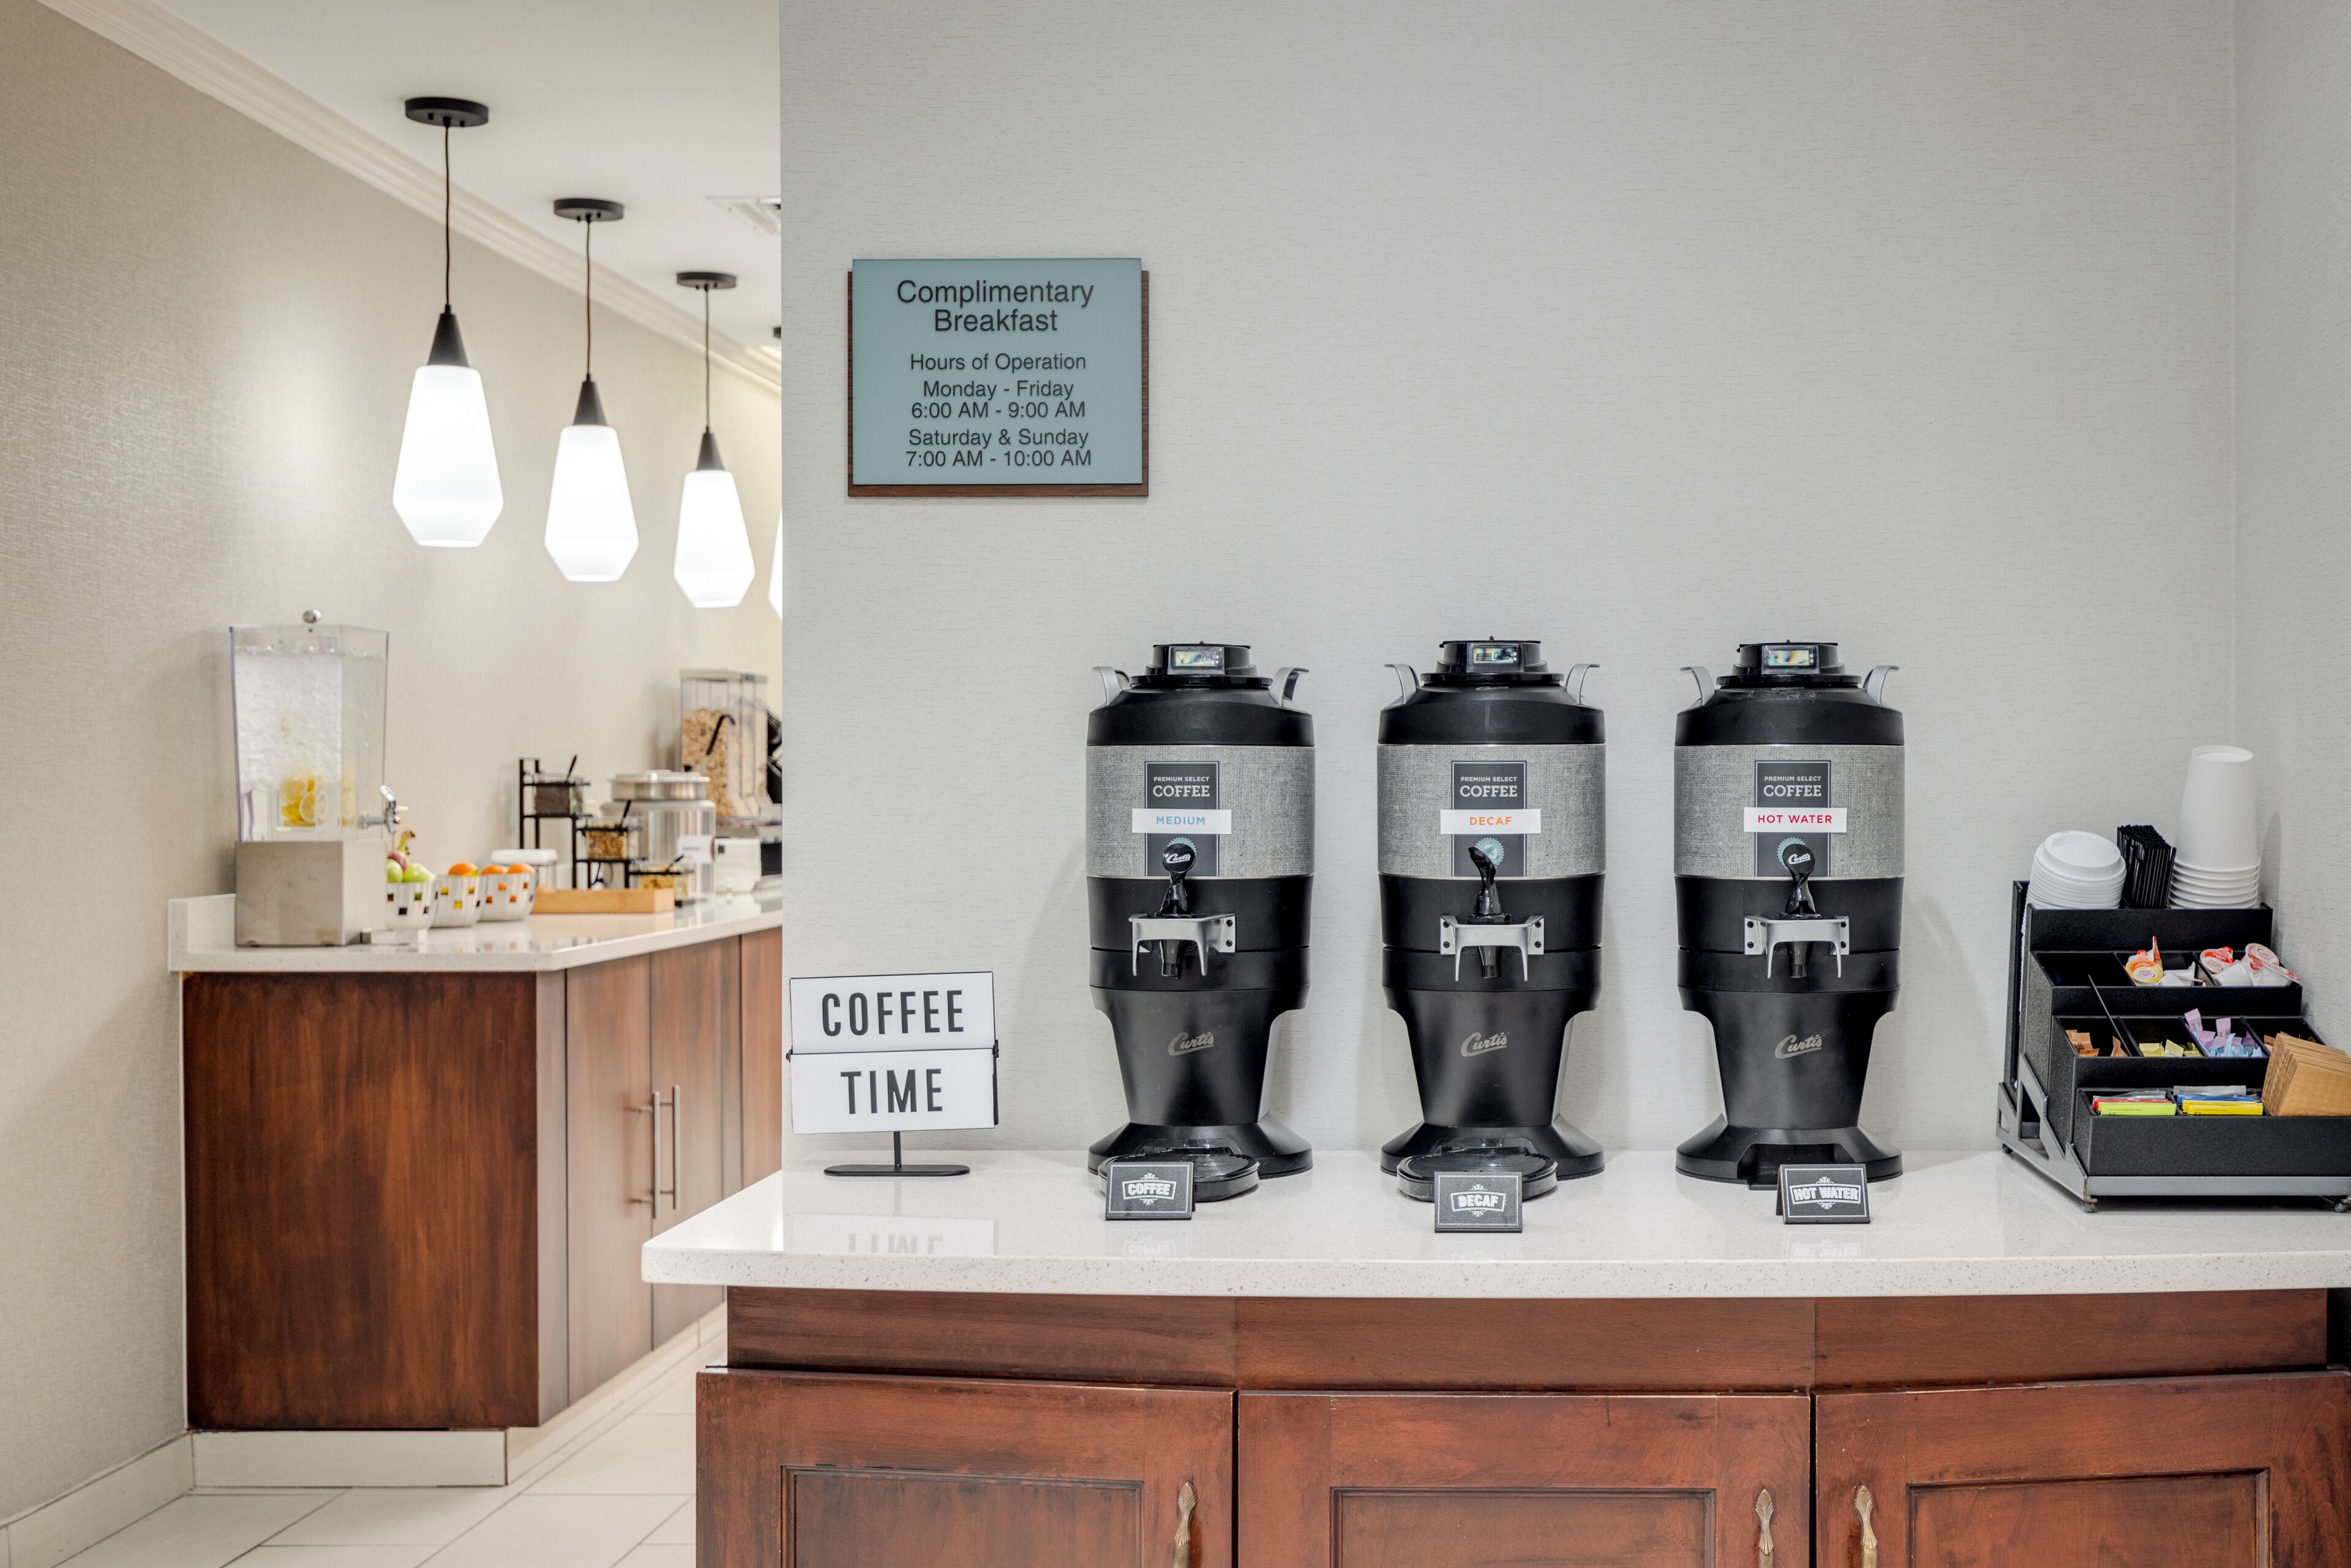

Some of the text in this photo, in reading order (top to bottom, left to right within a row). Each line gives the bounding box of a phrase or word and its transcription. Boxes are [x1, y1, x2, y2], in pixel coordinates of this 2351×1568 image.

[897, 280, 1093, 308] Complimentary
[935, 309, 1057, 331] Breakfast
[910, 353, 1086, 373] Hours of Operation
[924, 381, 997, 400] Monday
[1017, 380, 1073, 400] Friday
[912, 402, 951, 418] 6:00
[958, 402, 988, 418] AM
[1008, 402, 1048, 418] 9:00
[1055, 401, 1085, 418] AM
[909, 429, 1089, 449] Saturday & Sunday
[906, 451, 946, 467] 7:00
[953, 451, 983, 467] AM
[1004, 451, 1054, 467] 10:00
[1060, 450, 1091, 466] AM
[1153, 785, 1210, 797] COFFEE
[1460, 785, 1517, 797] COFFEE
[1763, 784, 1821, 797] COFFEE
[1156, 816, 1205, 825] MEDIUM
[1469, 816, 1512, 825] DECAF
[1758, 814, 1832, 823] HOT WATER
[822, 989, 964, 1037] COFFEE
[1168, 1032, 1215, 1057] Curtis
[1460, 1032, 1508, 1057] Curtis
[1774, 1033, 1823, 1059] Curtis
[841, 1068, 943, 1114] TIME
[1127, 1182, 1171, 1196] COFFEE
[1793, 1187, 1859, 1201] HOT WATER
[1458, 1195, 1499, 1208] DECAF
